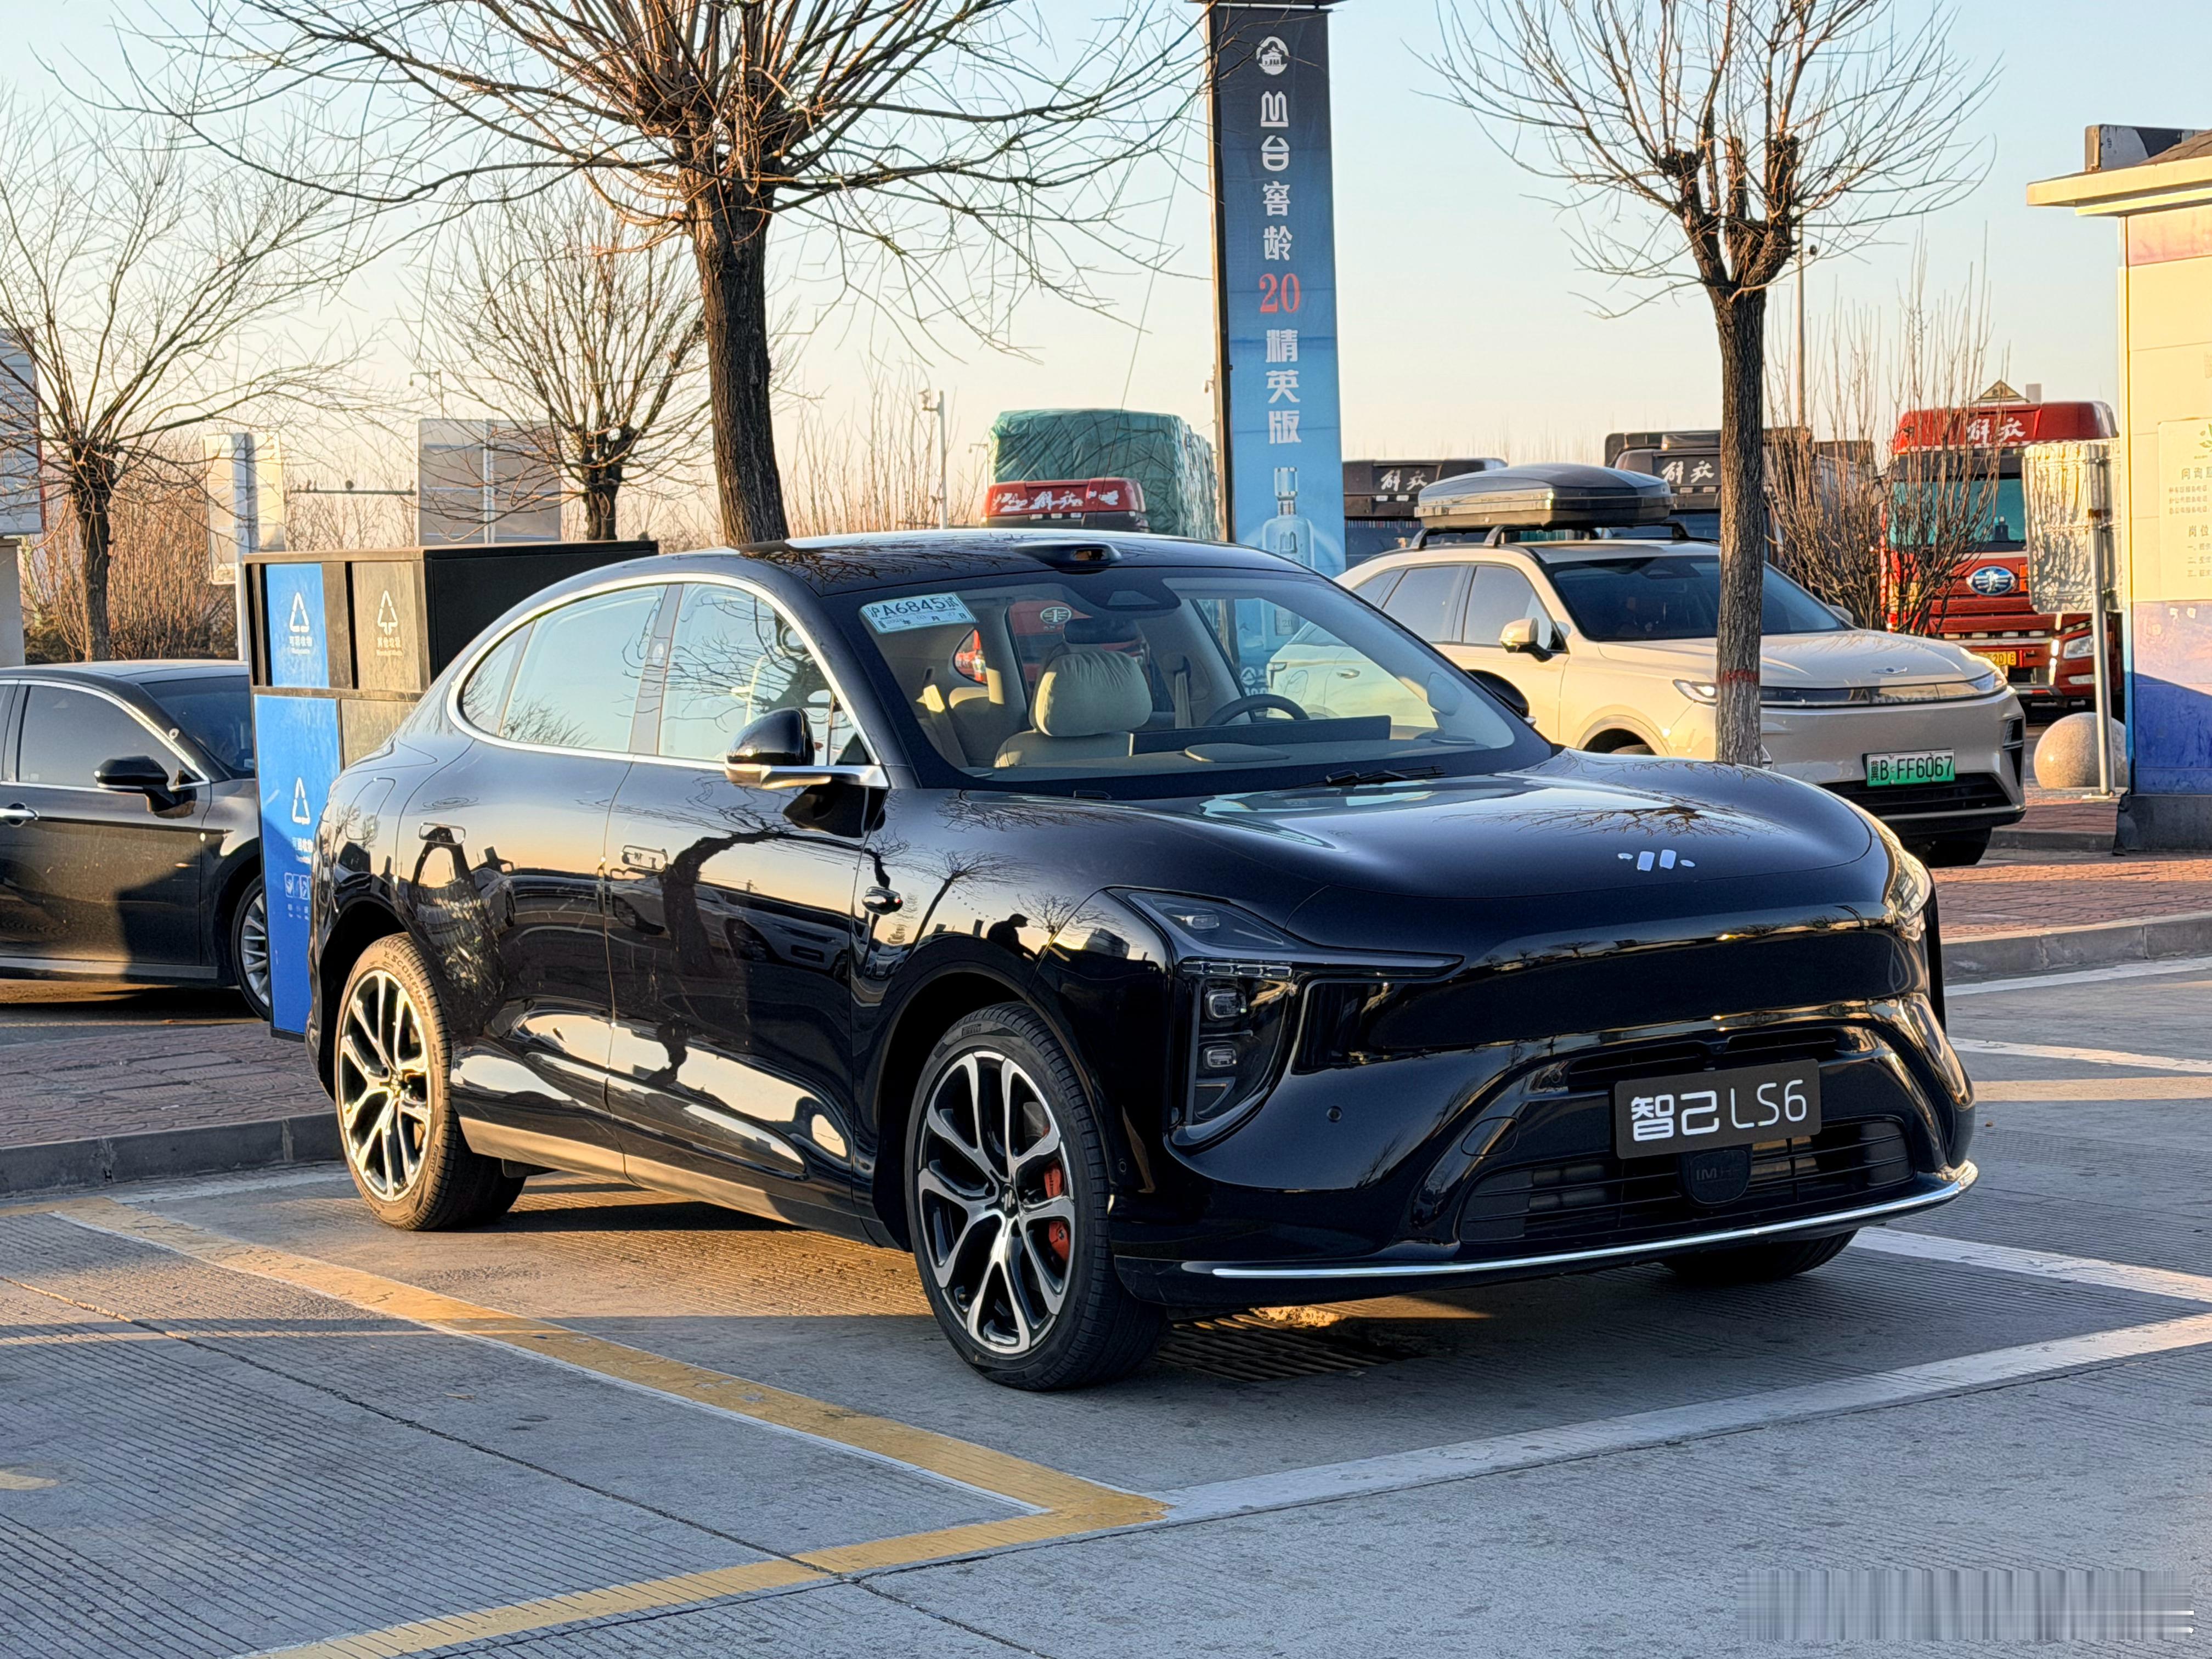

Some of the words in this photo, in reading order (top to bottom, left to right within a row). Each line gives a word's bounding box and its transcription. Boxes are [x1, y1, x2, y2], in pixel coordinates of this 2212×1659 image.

[1381, 470, 1427, 491] 解放
[1661, 460, 1714, 484] 解放
[867, 596, 959, 618] 沪A6845试
